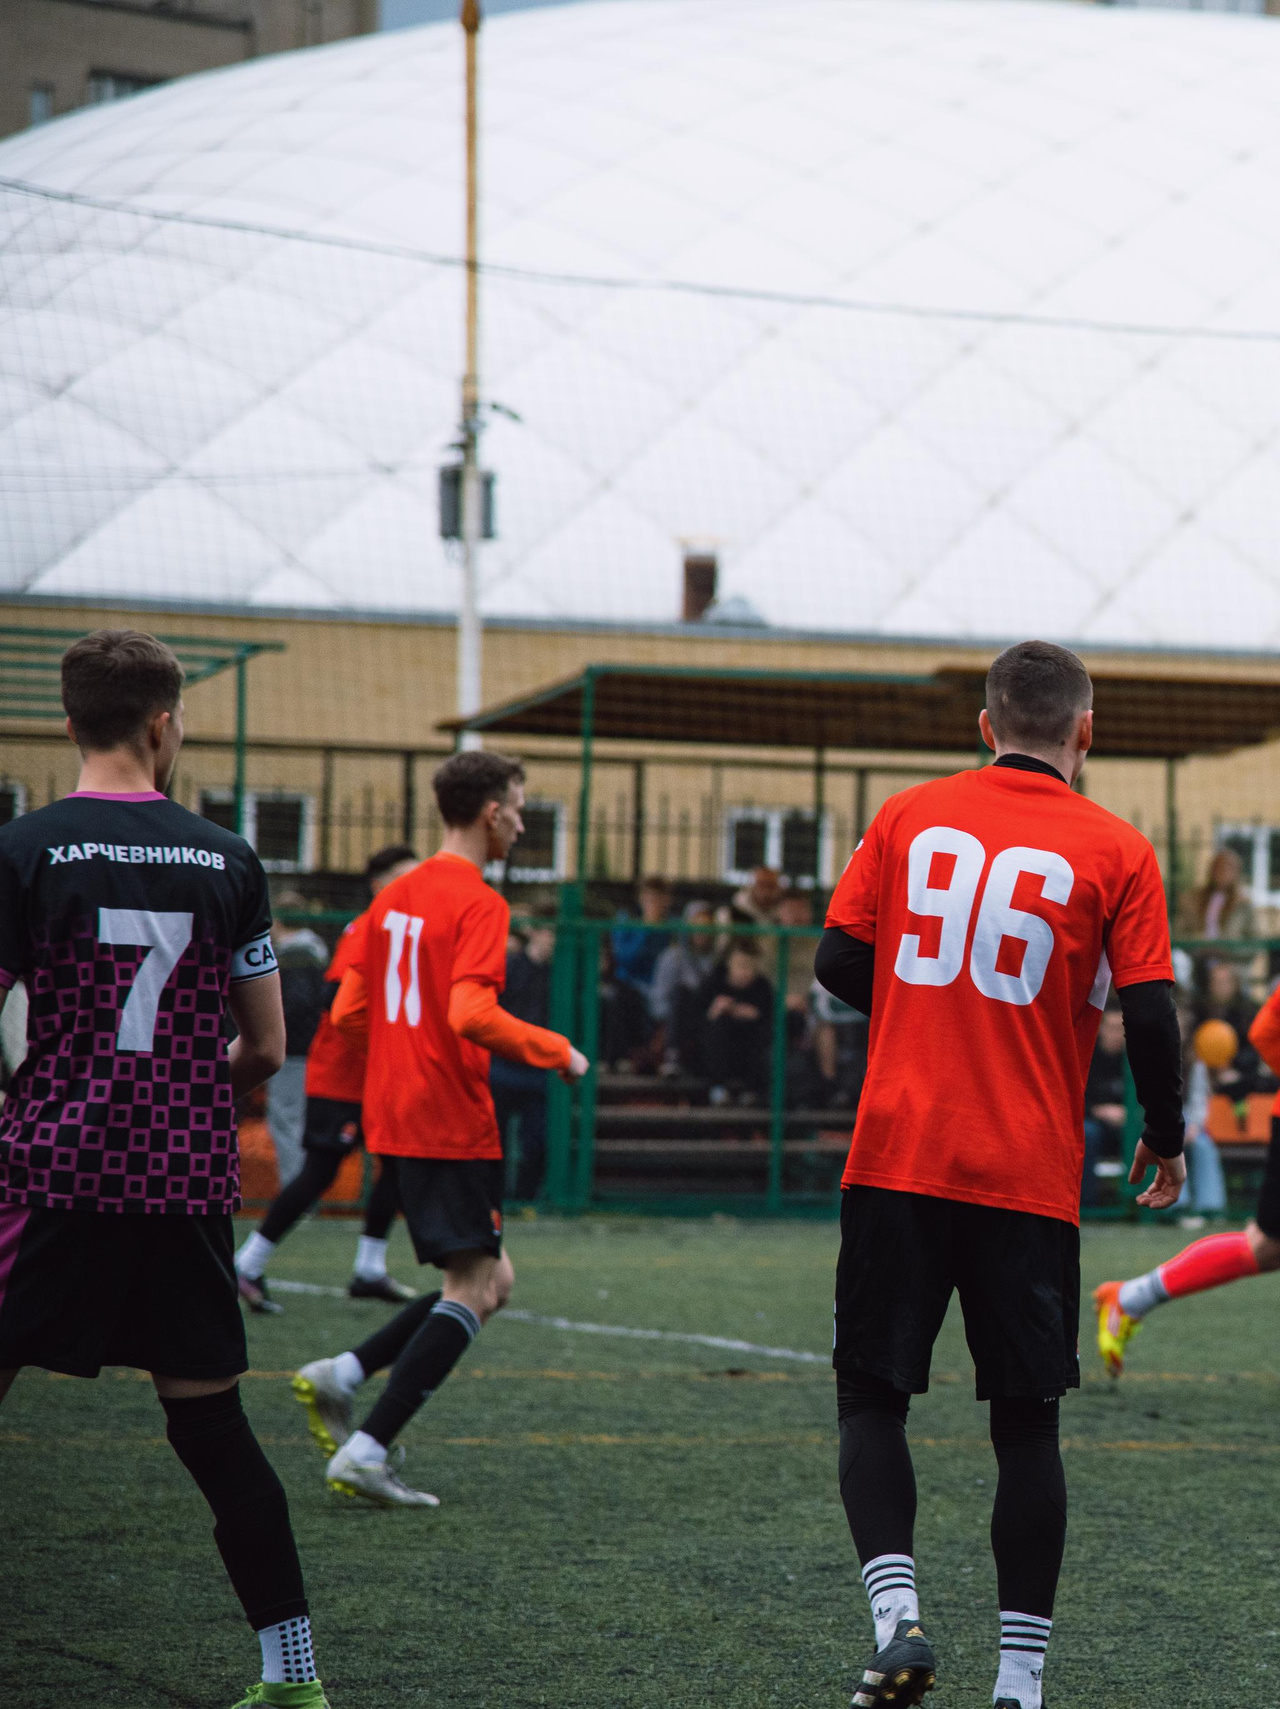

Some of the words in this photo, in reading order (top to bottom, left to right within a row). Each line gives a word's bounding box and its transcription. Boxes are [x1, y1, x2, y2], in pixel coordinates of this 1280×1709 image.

[48, 842, 226, 871] ХАРЧЕВНИКОВ
[894, 826, 1075, 1006] 96
[98, 907, 194, 1053] 7
[381, 909, 424, 1028] 11
